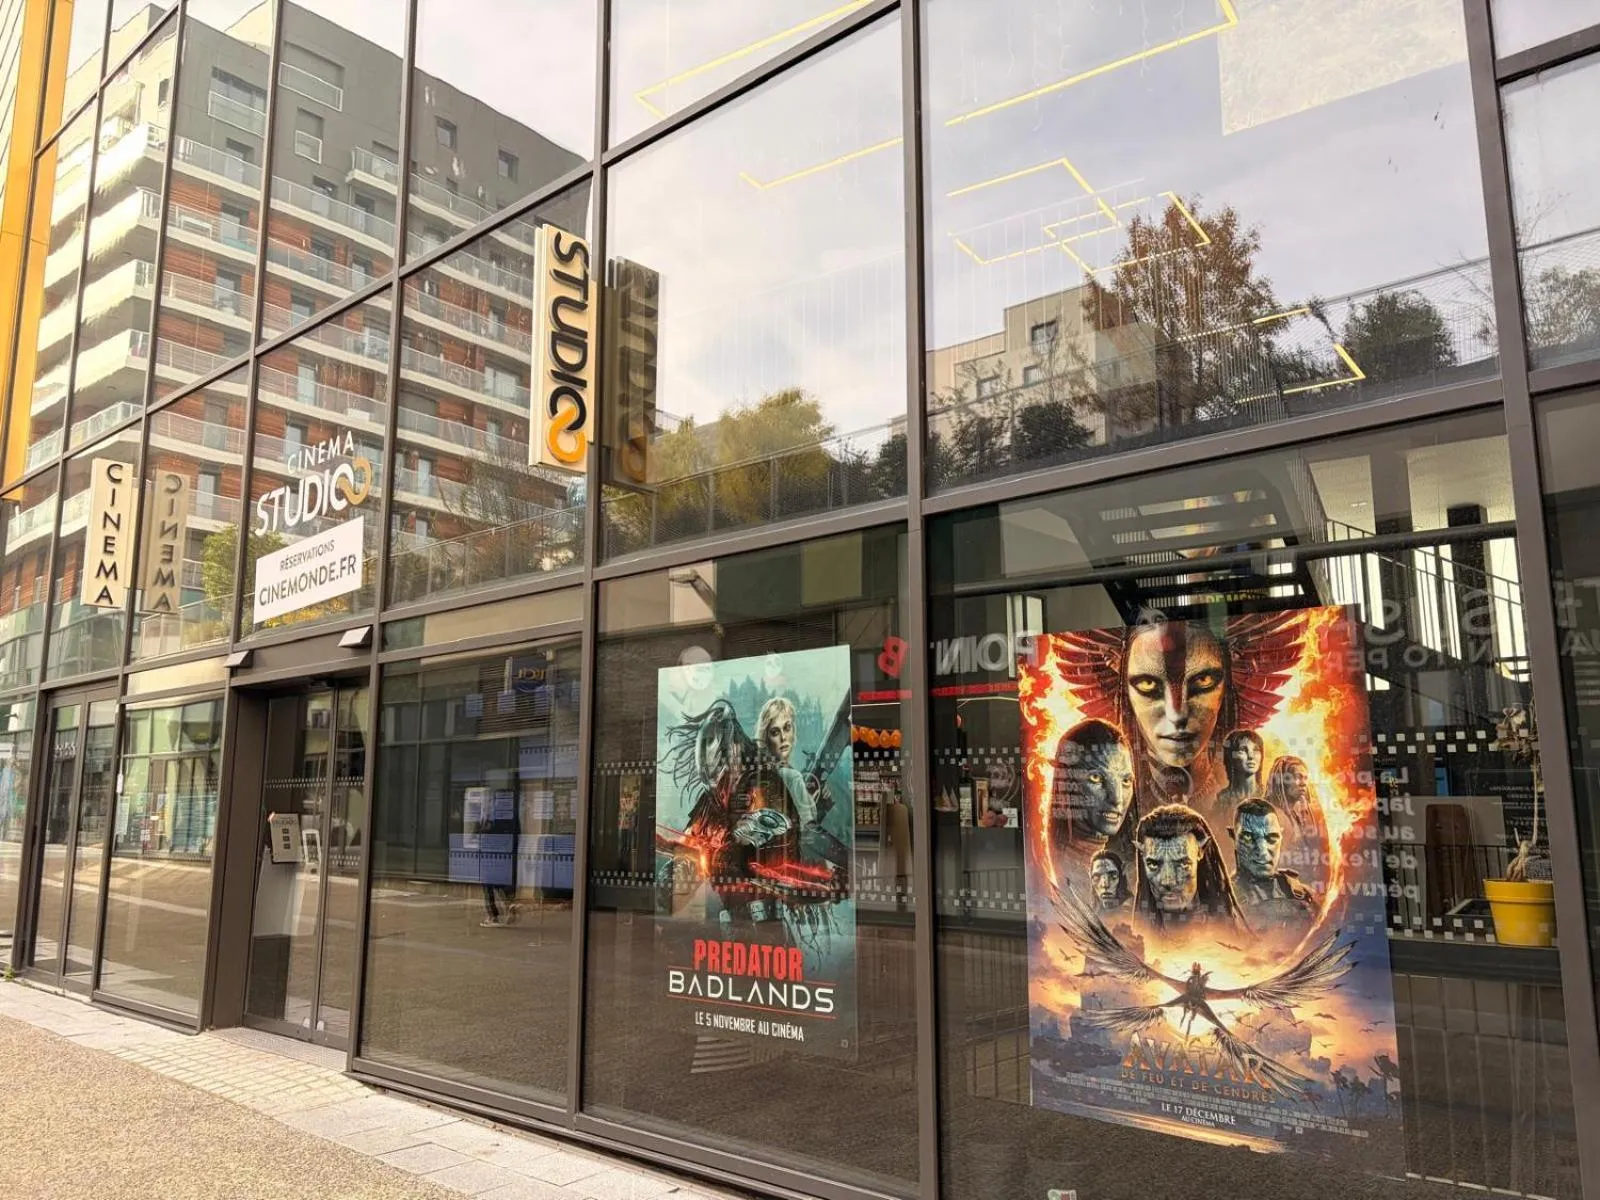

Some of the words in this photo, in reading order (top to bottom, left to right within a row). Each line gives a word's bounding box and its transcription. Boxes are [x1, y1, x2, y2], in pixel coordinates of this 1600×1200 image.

[287, 430, 354, 475] CINEMA
[94, 463, 123, 605] CINEMA
[280, 539, 336, 571] RÉSERVATIONS
[259, 554, 357, 606] CINEMONDE.FR
[693, 939, 804, 982] PREDATOR
[669, 970, 834, 1013] BADLANDS
[695, 1011, 704, 1025] LE
[706, 1012, 712, 1027] 5
[713, 1014, 756, 1034] NOVEMBRE
[757, 1020, 769, 1036] AU
[771, 1022, 804, 1042] CINÉMA
[1121, 1071, 1136, 1080] DE
[1142, 1072, 1164, 1085] FEU
[1171, 1076, 1184, 1088] ET
[1191, 1080, 1208, 1092] DE
[1122, 1031, 1273, 1089] AVATAR
[1161, 1102, 1171, 1112] LE
[1174, 1105, 1183, 1114] 17
[1186, 1107, 1236, 1126] DÉCEMBRE
